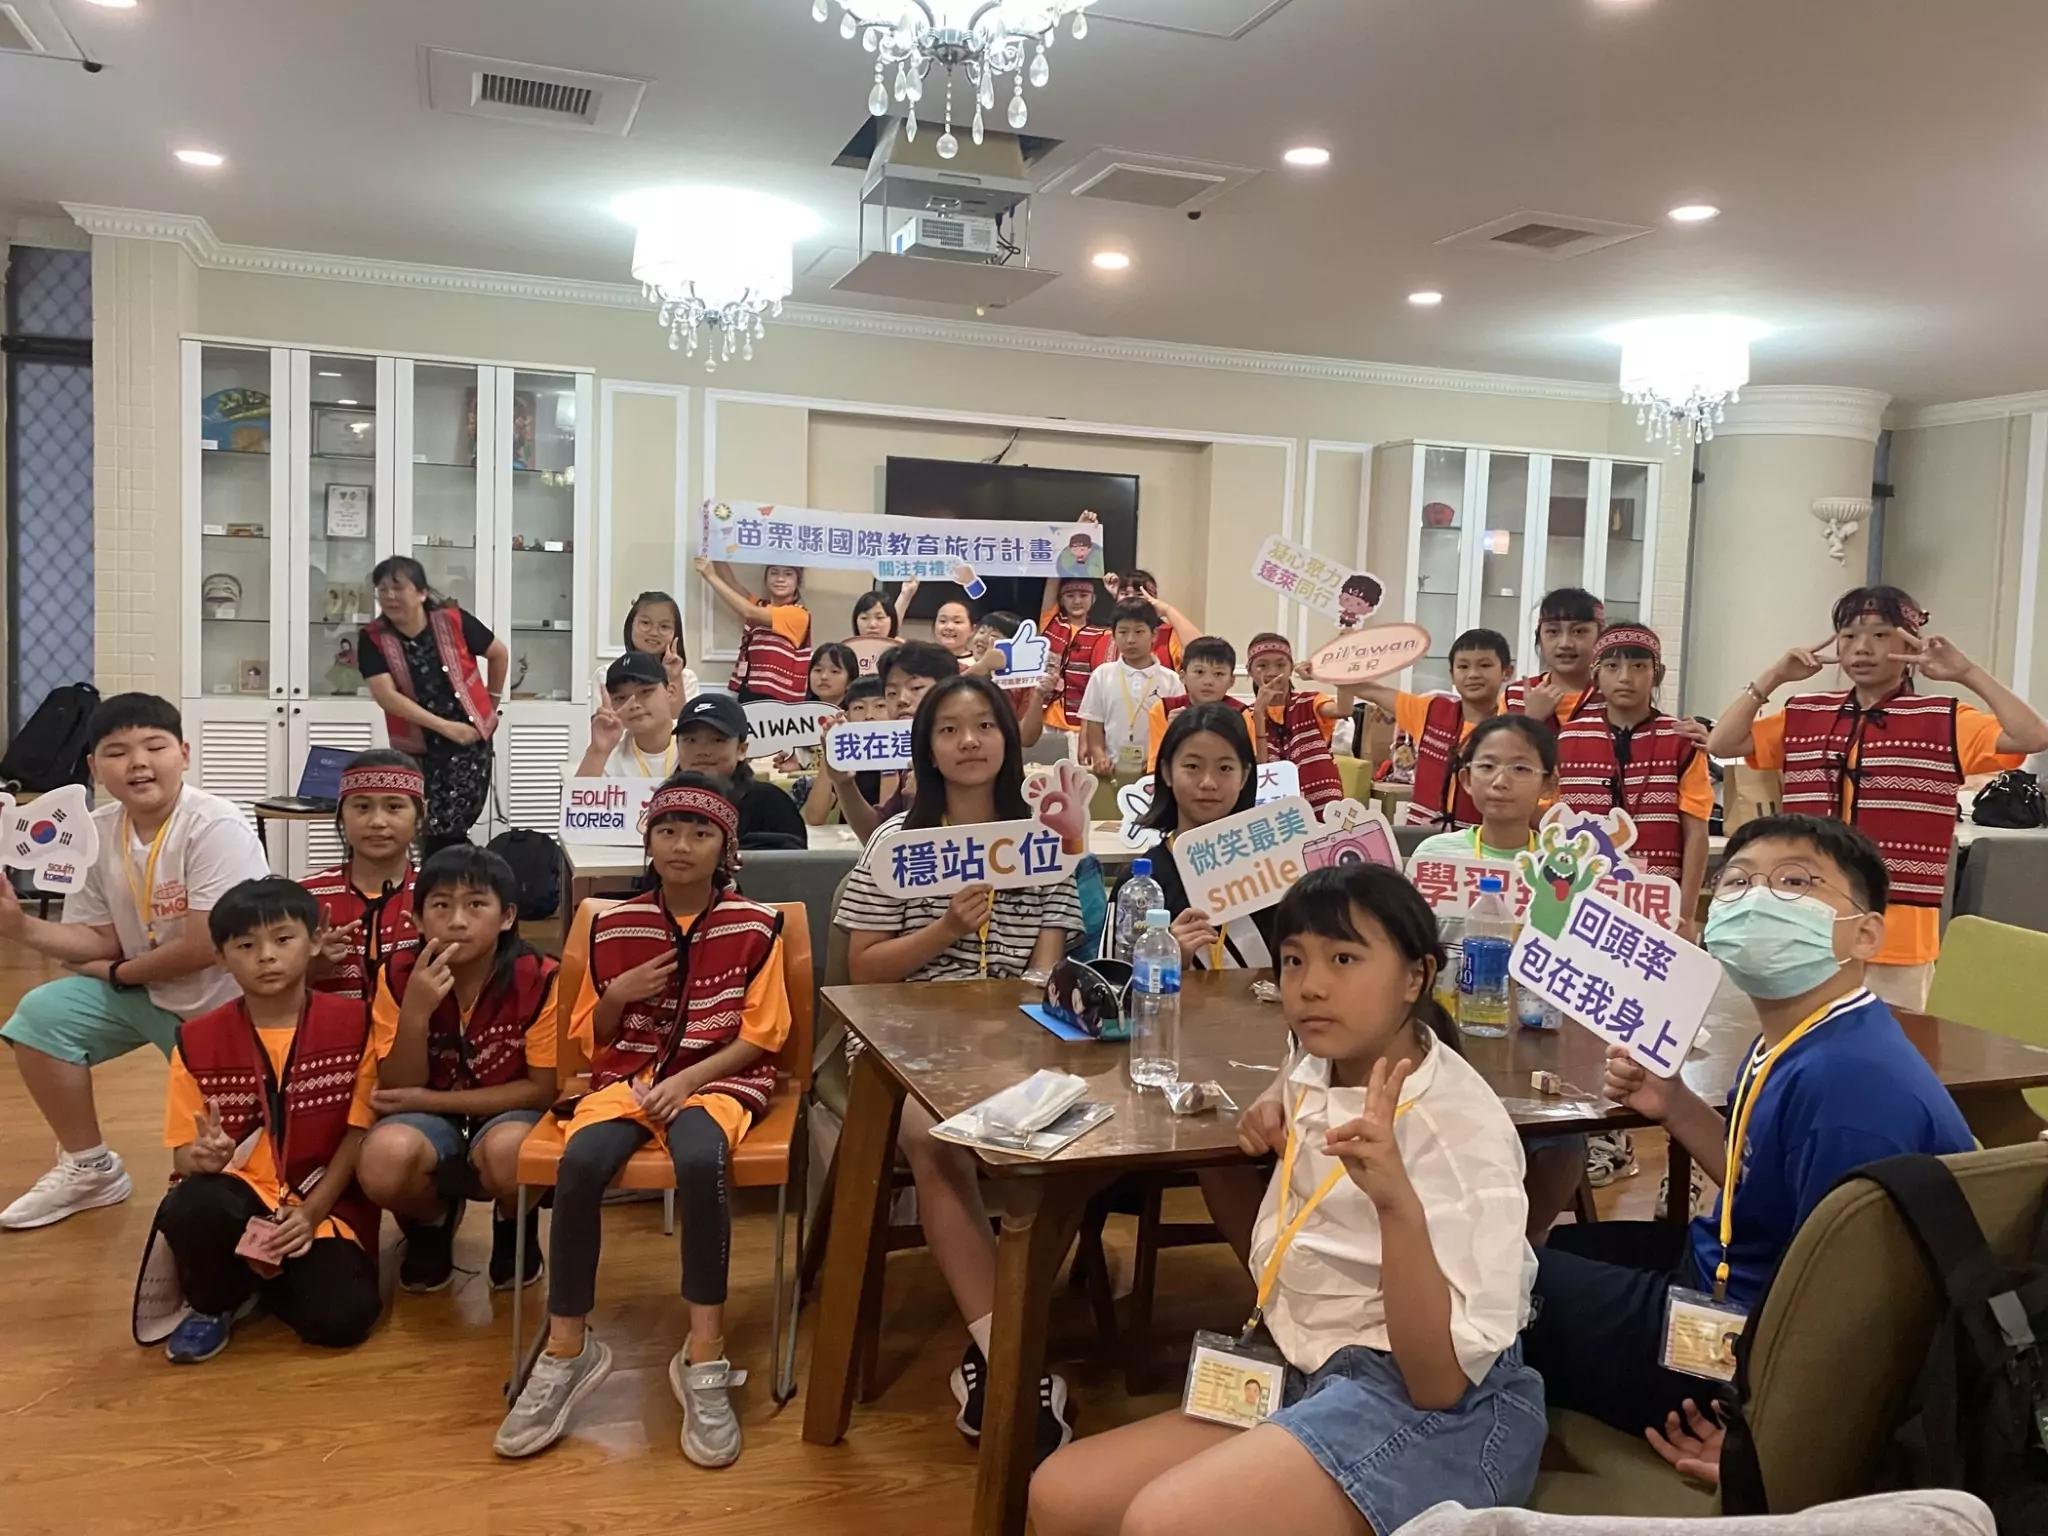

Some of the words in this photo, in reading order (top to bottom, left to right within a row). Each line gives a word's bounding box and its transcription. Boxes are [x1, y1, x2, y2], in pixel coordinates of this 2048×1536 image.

[737, 518, 1054, 562] 苗栗縣國際教育旅行計畫
[878, 560, 946, 577] 關注有禮
[1257, 559, 1334, 608] 蓬萊同行
[744, 715, 815, 739] AIWAN
[891, 829, 1063, 889] 穩站C位
[1186, 806, 1309, 877] 微笑最美
[1207, 857, 1300, 913] smile
[1568, 897, 1678, 982] 回頭率
[1518, 936, 1679, 1070] 包在我身上
